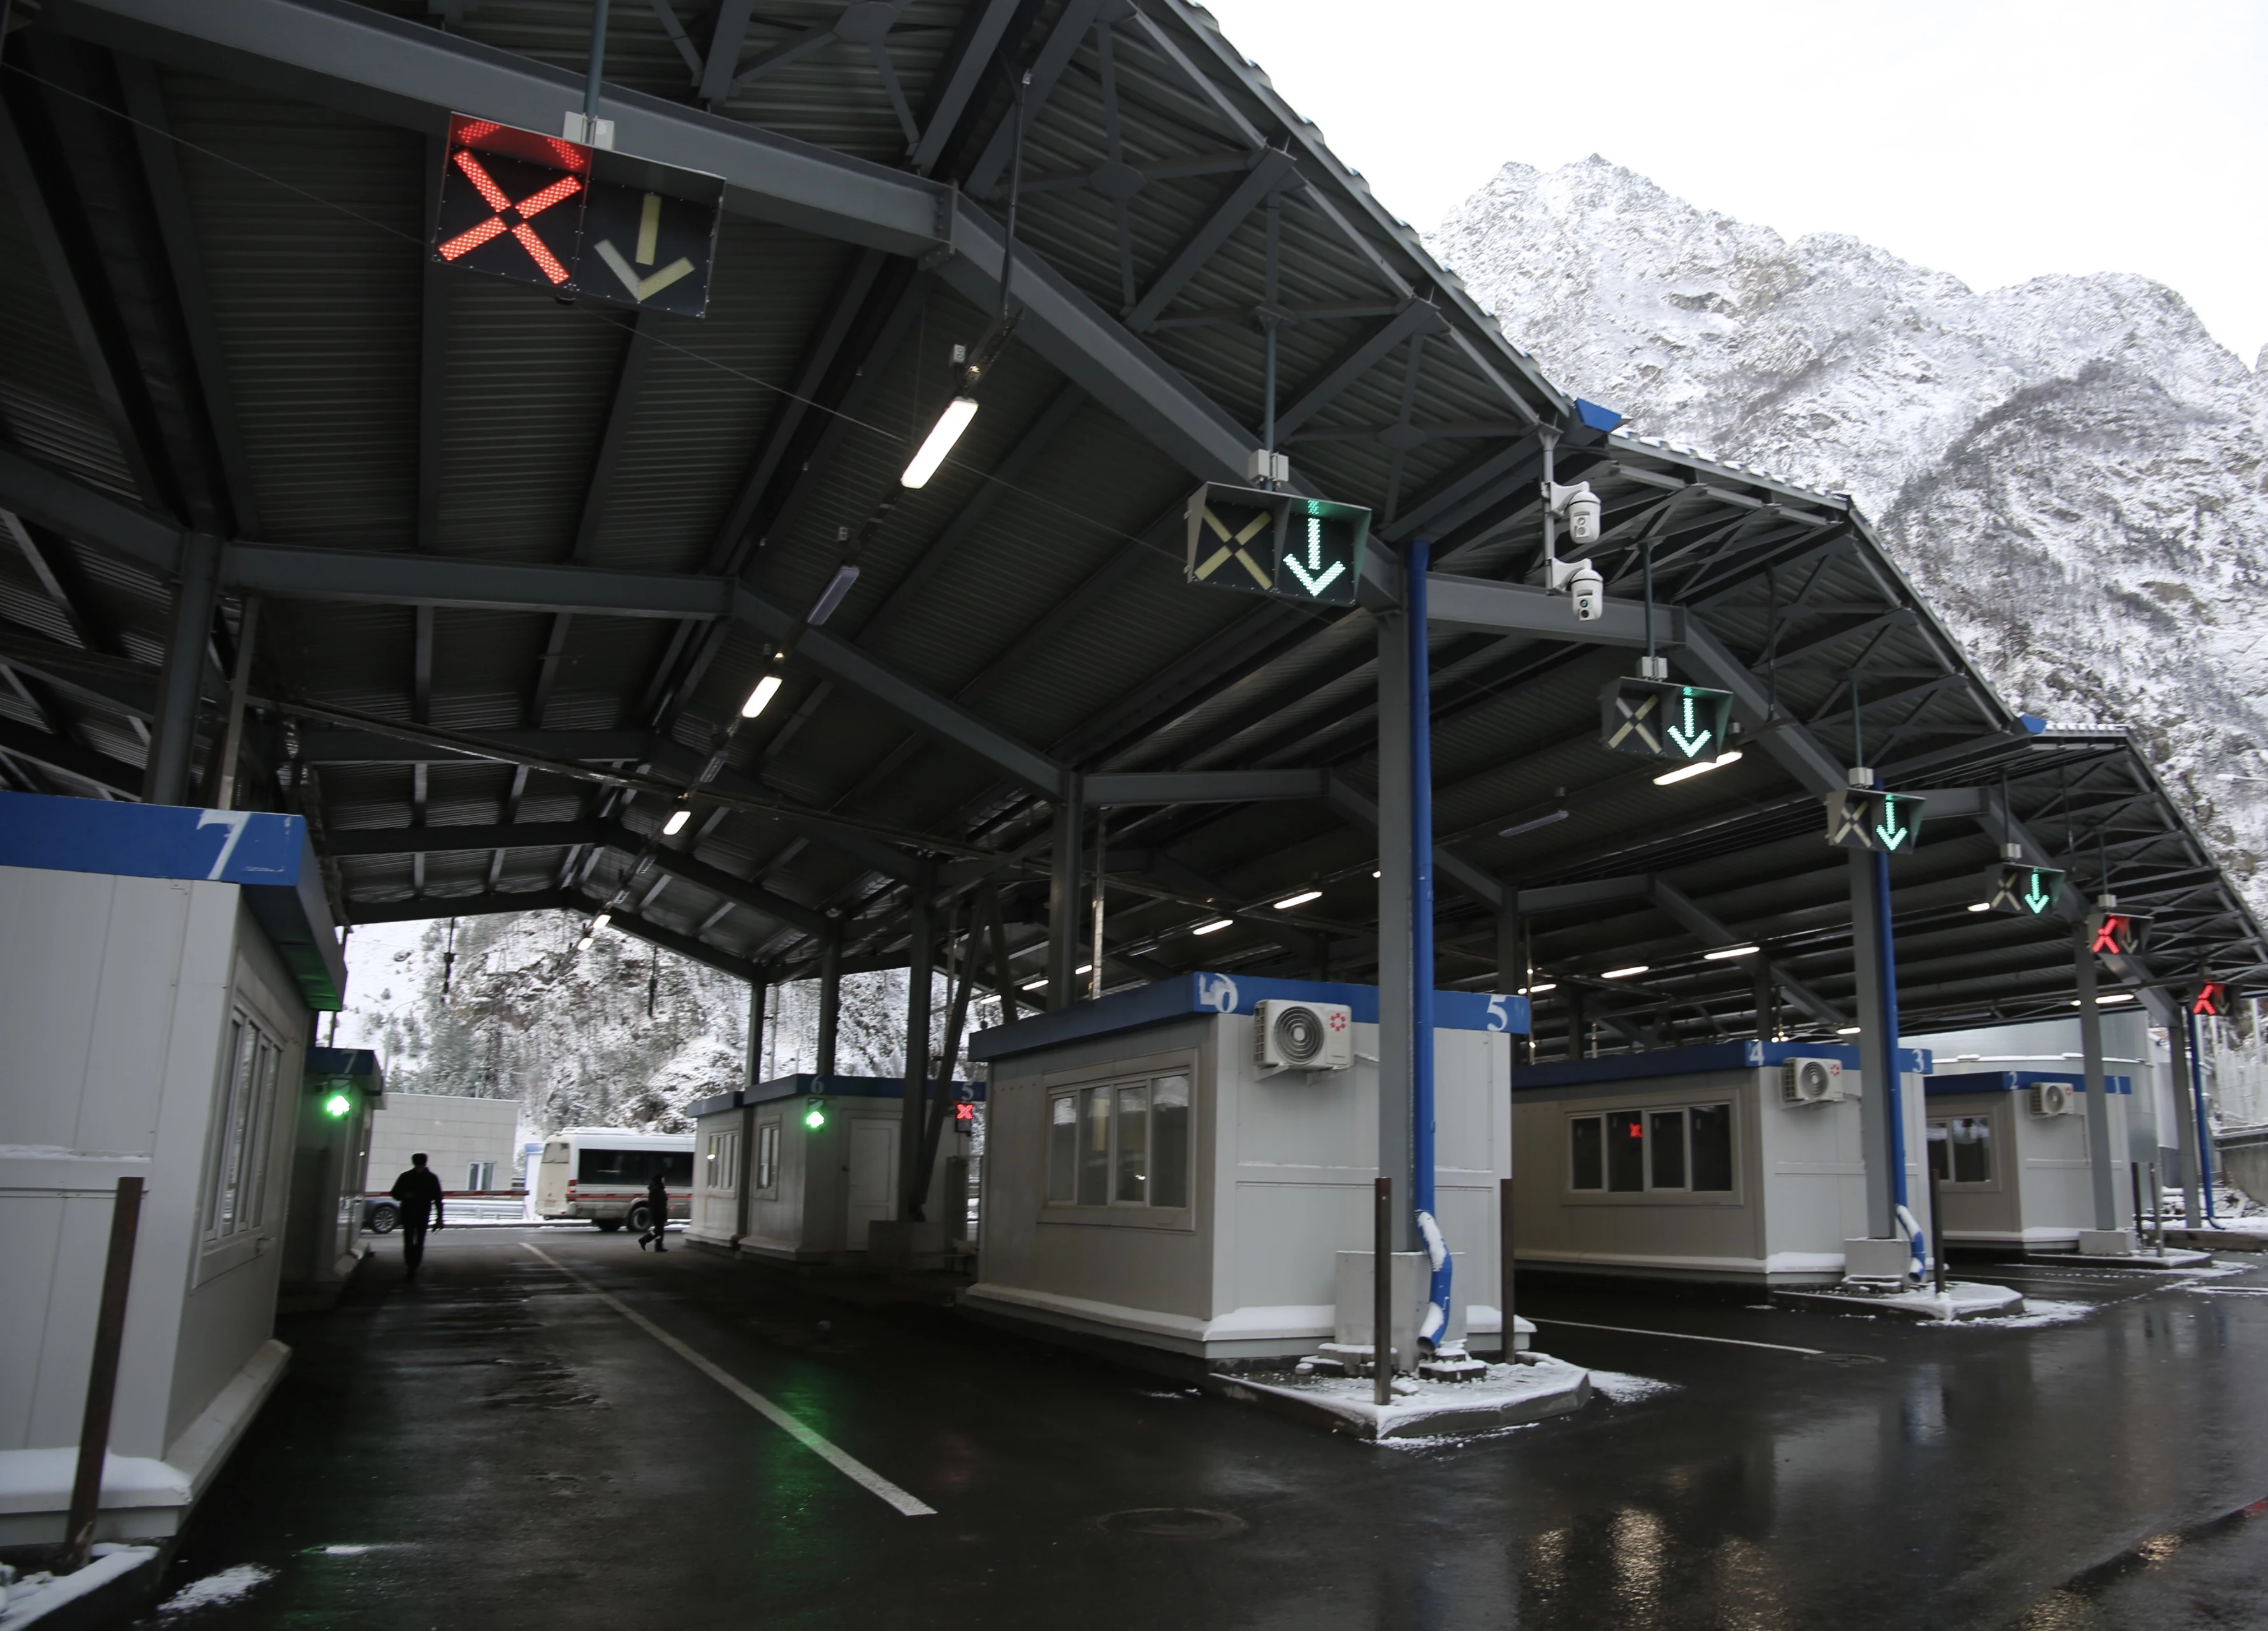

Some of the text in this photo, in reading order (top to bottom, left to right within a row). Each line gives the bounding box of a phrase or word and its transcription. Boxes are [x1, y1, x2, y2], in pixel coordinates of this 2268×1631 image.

[196, 809, 252, 880] 7
[1486, 994, 1508, 1032] 5
[340, 1049, 358, 1074] 7
[1749, 1040, 1765, 1066] 4
[1912, 1048, 1925, 1073] 3
[810, 1074, 825, 1094] 6
[961, 1081, 974, 1101] 5
[2008, 1071, 2018, 1090] 2
[2113, 1076, 2123, 1094] 1
